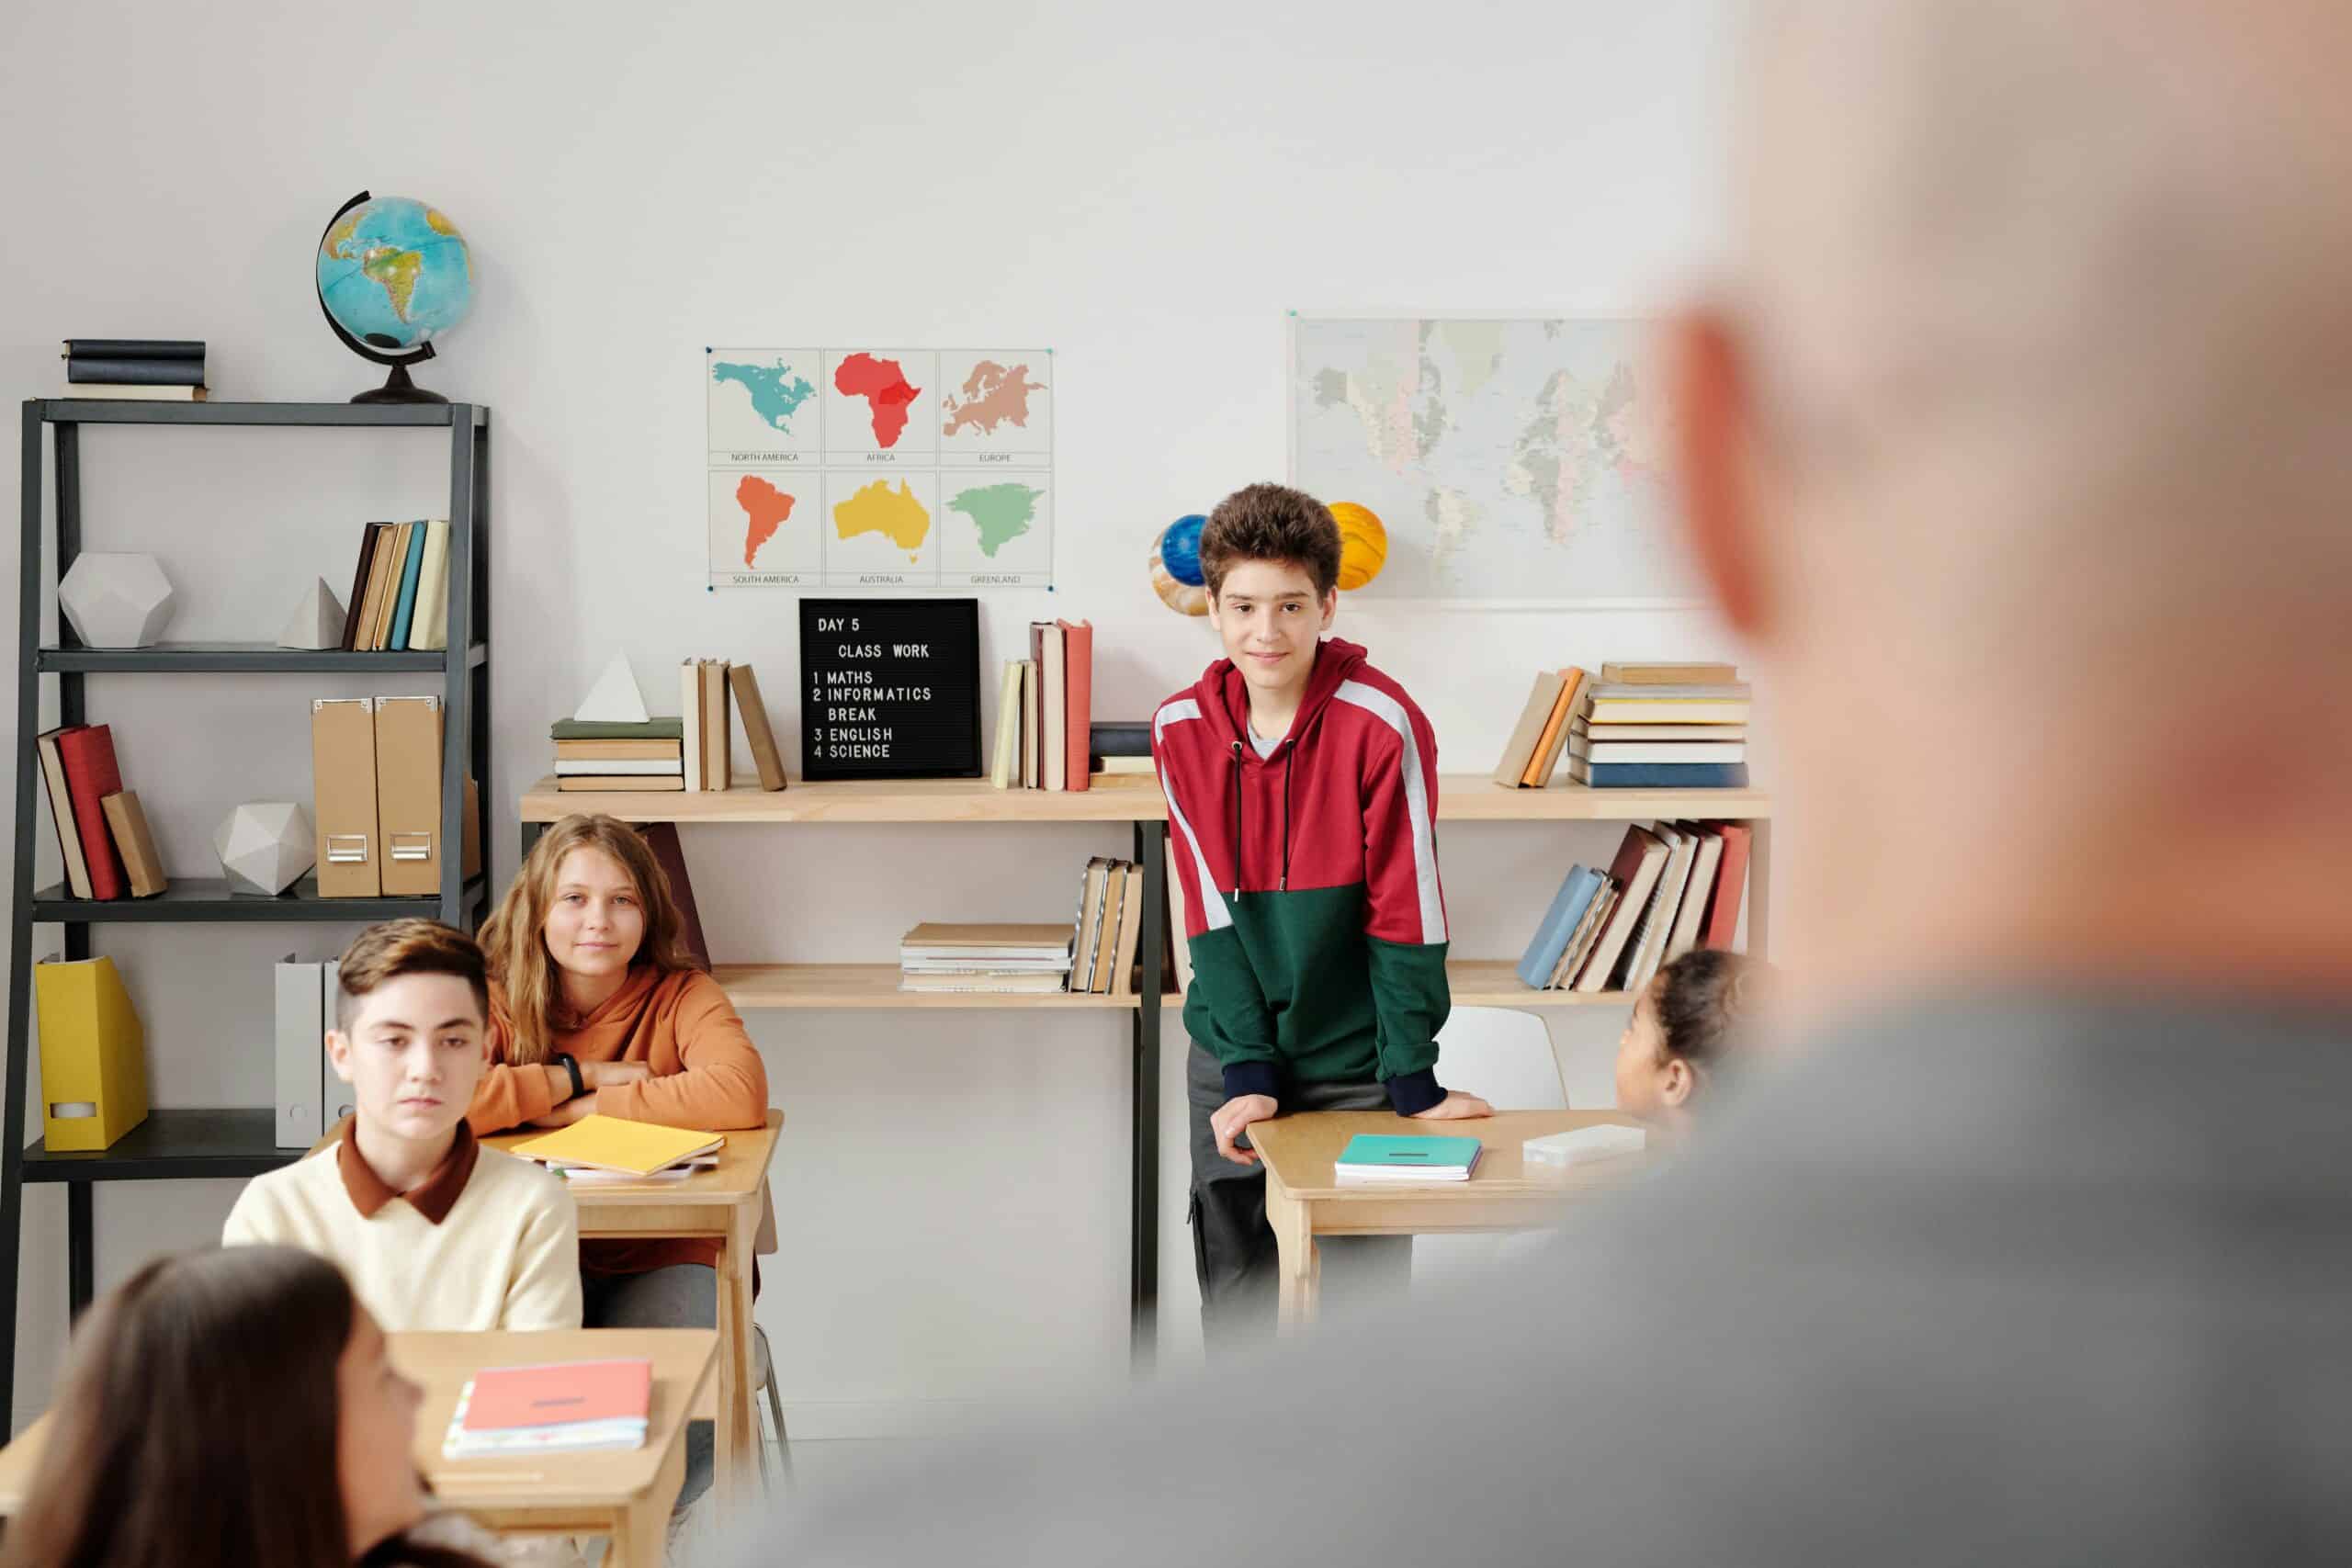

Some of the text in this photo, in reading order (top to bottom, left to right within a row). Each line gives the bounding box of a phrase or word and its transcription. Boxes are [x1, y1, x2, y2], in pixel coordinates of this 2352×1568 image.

[731, 453, 798, 462] NORTH AMERICA
[866, 453, 896, 462] AFRICA
[978, 454, 1012, 463] EUROPE
[732, 575, 799, 584] SOUTH AMERICA
[859, 574, 903, 584] AUSTRALIA
[970, 575, 1021, 584] GREENLAND
[818, 618, 860, 632] DAY 5
[838, 644, 930, 658] CLASS WORK
[813, 671, 873, 684] 1 MATHS
[813, 687, 932, 701] 2 INFORMATICS
[828, 707, 876, 721] BREAK
[814, 728, 892, 741] 3 ENGLISH
[814, 745, 890, 758] 4 SCIENCE
